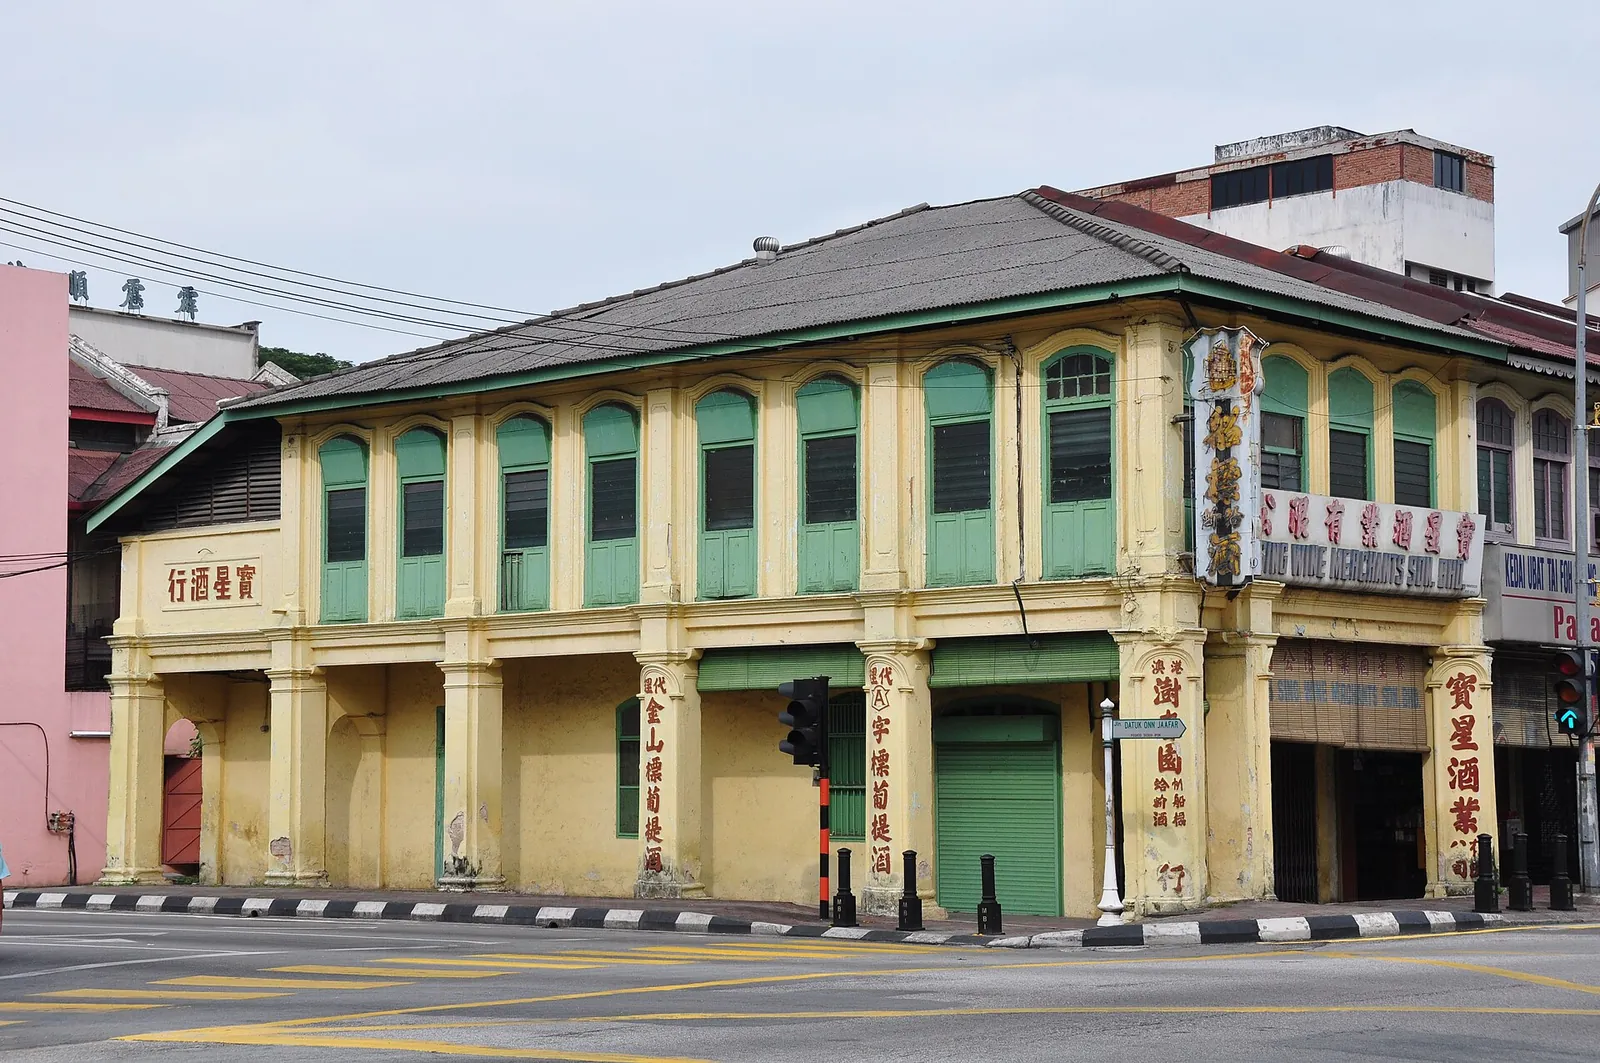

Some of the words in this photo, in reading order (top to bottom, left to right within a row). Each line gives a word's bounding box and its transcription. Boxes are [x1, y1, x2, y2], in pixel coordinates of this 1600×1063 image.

[1291, 543, 1327, 579] WINE
[1329, 547, 1406, 585] MERCHANTS
[1504, 553, 1526, 589] KEDAI
[1527, 556, 1544, 591] UBAT
[1547, 558, 1559, 592] TAI
[1560, 560, 1573, 594] FOH
[1124, 721, 1142, 729] DATUK
[1144, 721, 1155, 729] ONN
[1157, 721, 1179, 729] JAAFAR
